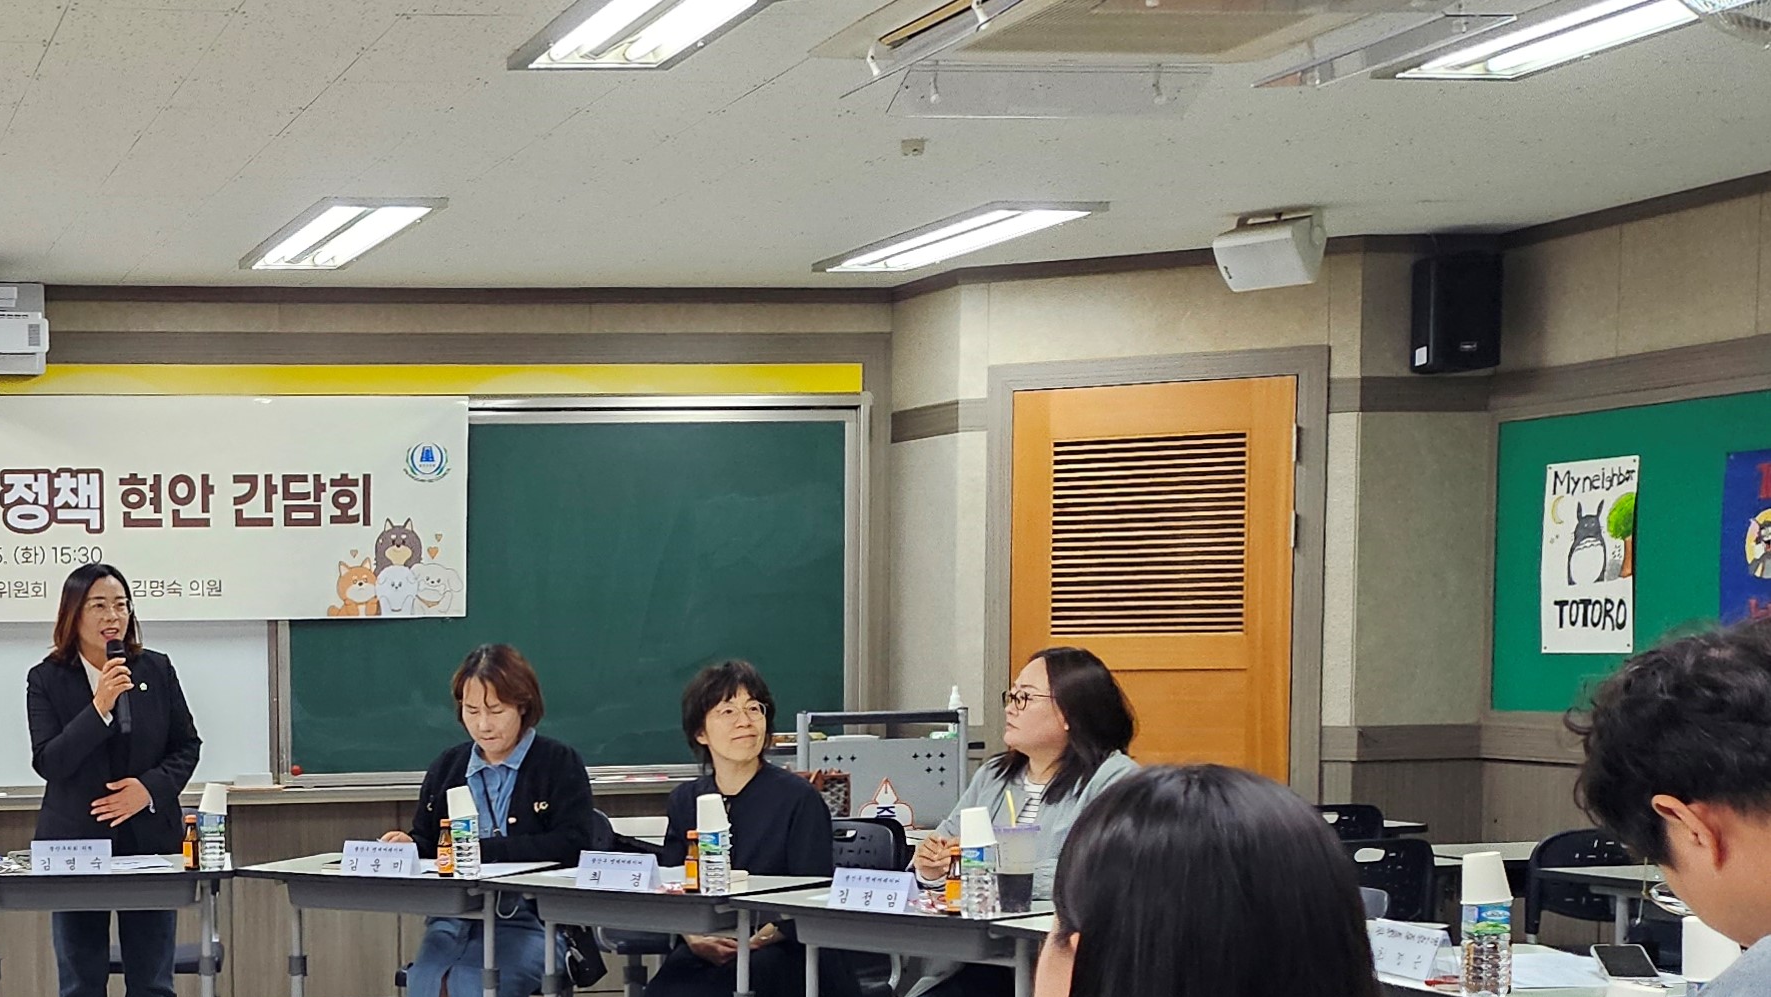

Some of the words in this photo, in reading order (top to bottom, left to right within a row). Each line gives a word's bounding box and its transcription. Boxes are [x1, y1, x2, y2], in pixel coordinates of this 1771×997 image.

[0, 468, 104, 534] 정책
[118, 473, 215, 529] 현안
[232, 473, 372, 528] 간담회
[13, 546, 46, 567] (화)
[51, 546, 103, 565] 15:30
[132, 579, 183, 599] 김명숙
[188, 579, 223, 598] 의원
[1554, 598, 1628, 632] TOTORO
